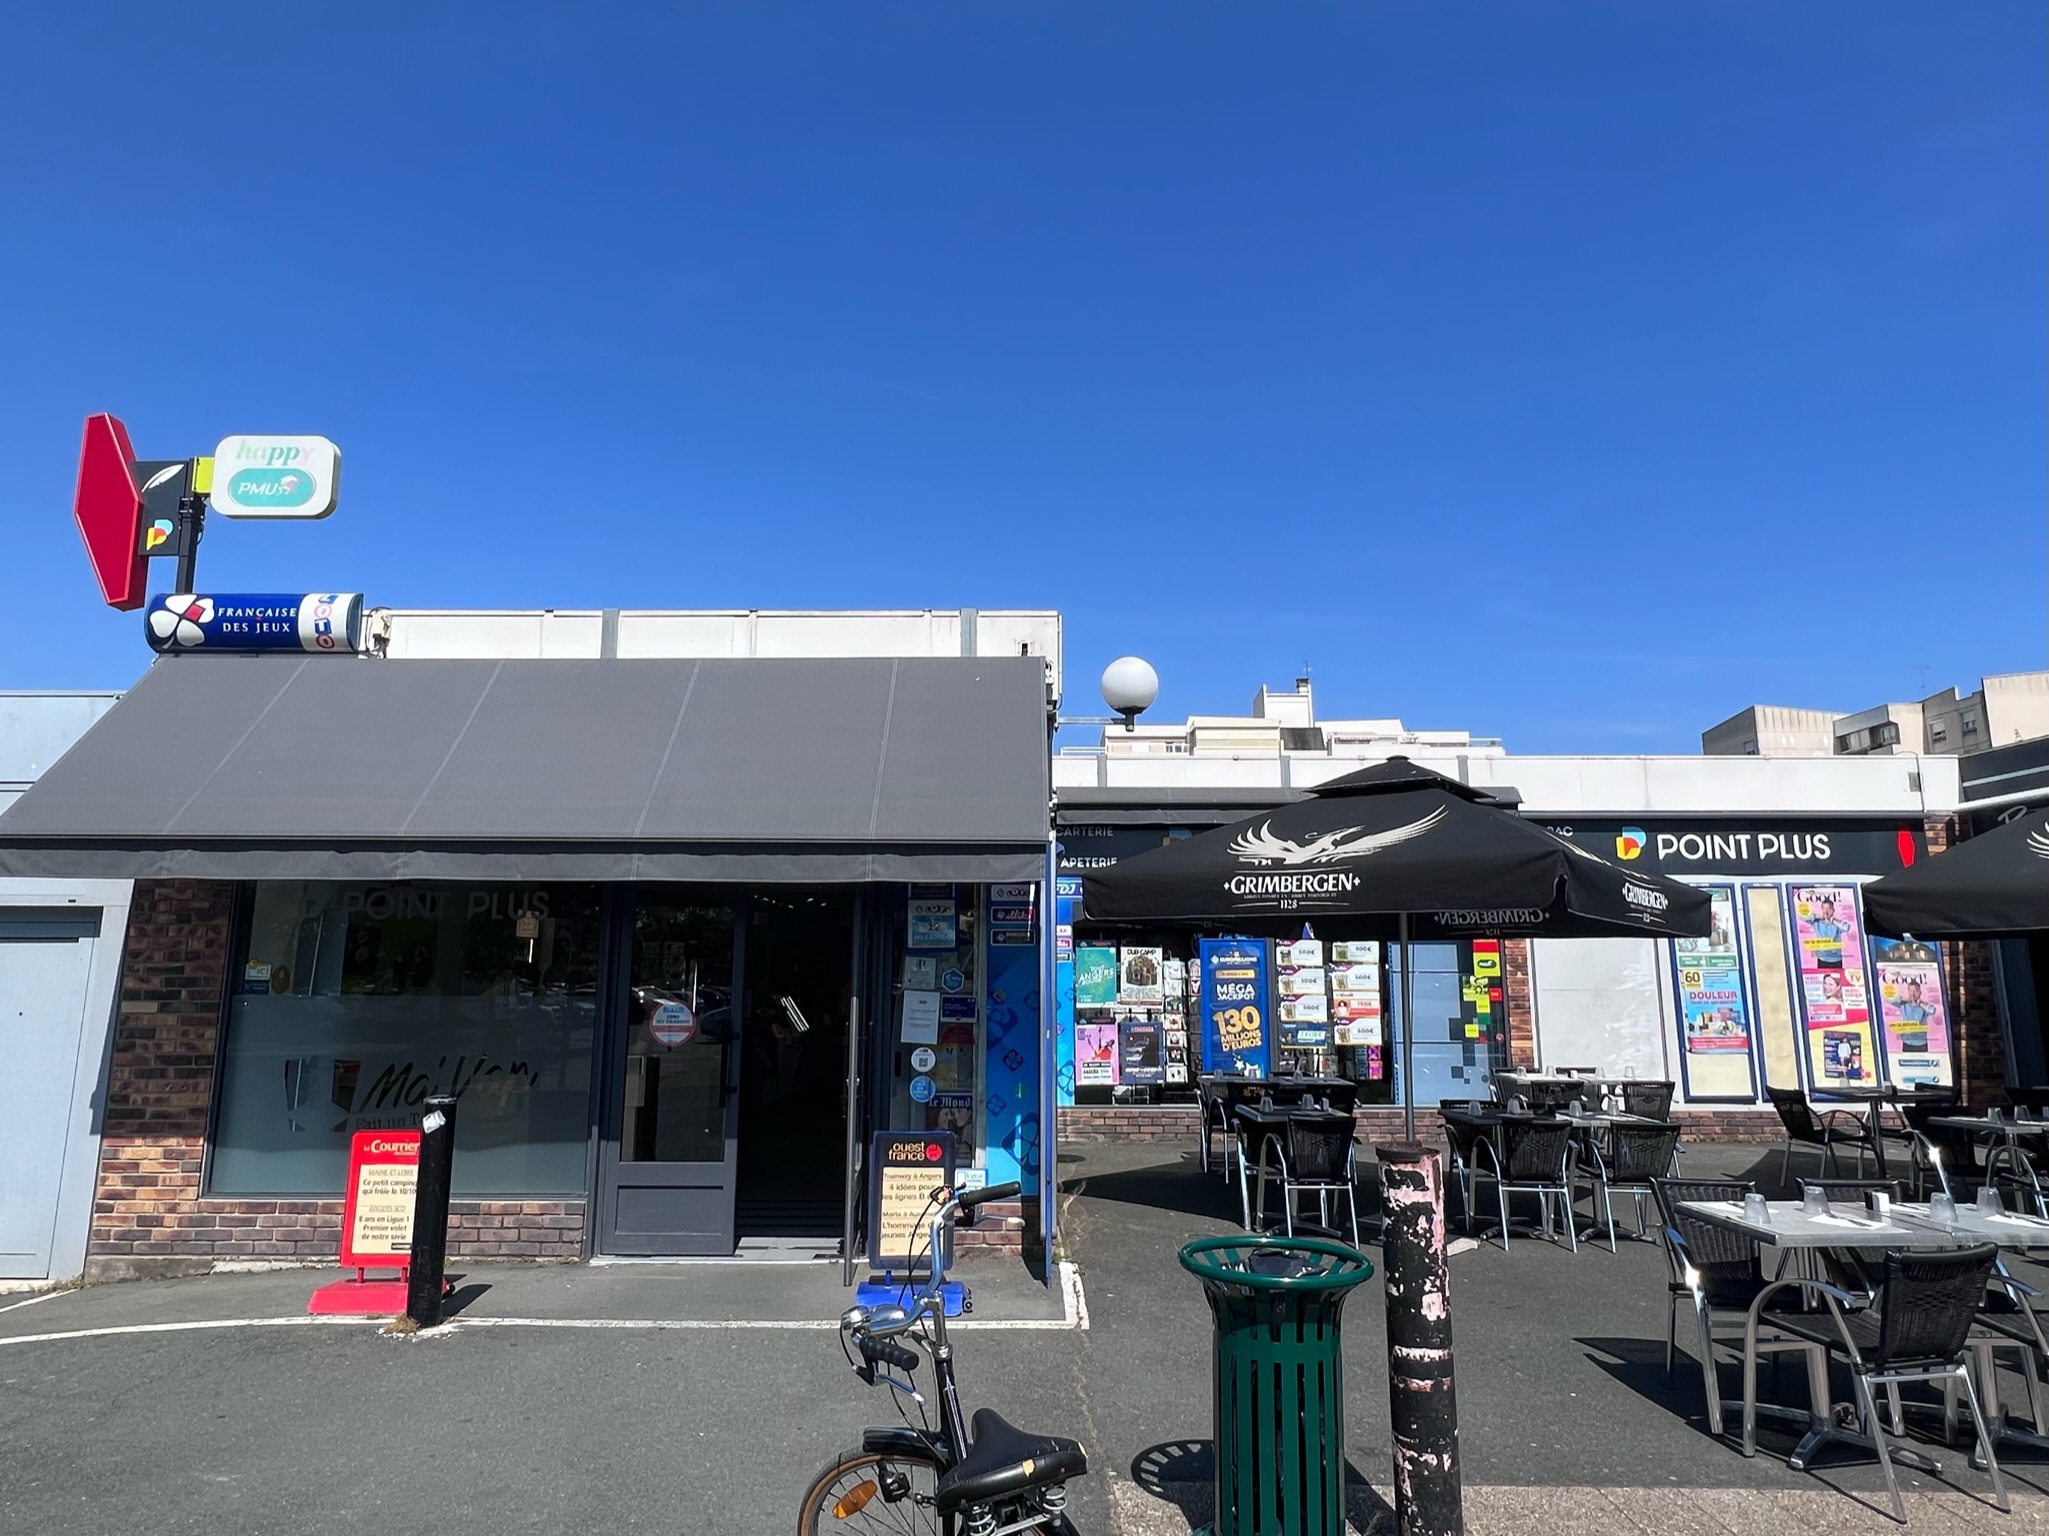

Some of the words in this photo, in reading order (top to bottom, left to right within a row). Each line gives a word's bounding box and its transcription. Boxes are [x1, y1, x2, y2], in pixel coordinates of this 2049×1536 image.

[235, 439, 315, 467] happy
[237, 481, 280, 496] PMU
[222, 622, 249, 633] DES
[255, 622, 291, 634] JEUX
[313, 594, 339, 649] LOTO
[1055, 826, 1114, 837] CARTERIE
[1656, 834, 1751, 860] POINT
[1757, 834, 1831, 860] PLUS
[1231, 872, 1353, 895] GRIMBERGEN
[1797, 890, 1842, 903] Good!
[1685, 971, 1700, 983] 60
[1882, 972, 1928, 985] Good!
[1217, 992, 1255, 1001] JACKPOT
[1689, 990, 1738, 1000] DOULEUR
[1212, 1005, 1261, 1035] 130
[1220, 1028, 1262, 1044] MILLIONS
[1222, 1038, 1262, 1052] D'EUROS
[893, 1141, 925, 1152] ouest
[888, 1149, 925, 1161] france
[372, 1179, 389, 1189] petit
[895, 1192, 917, 1202] lignes
